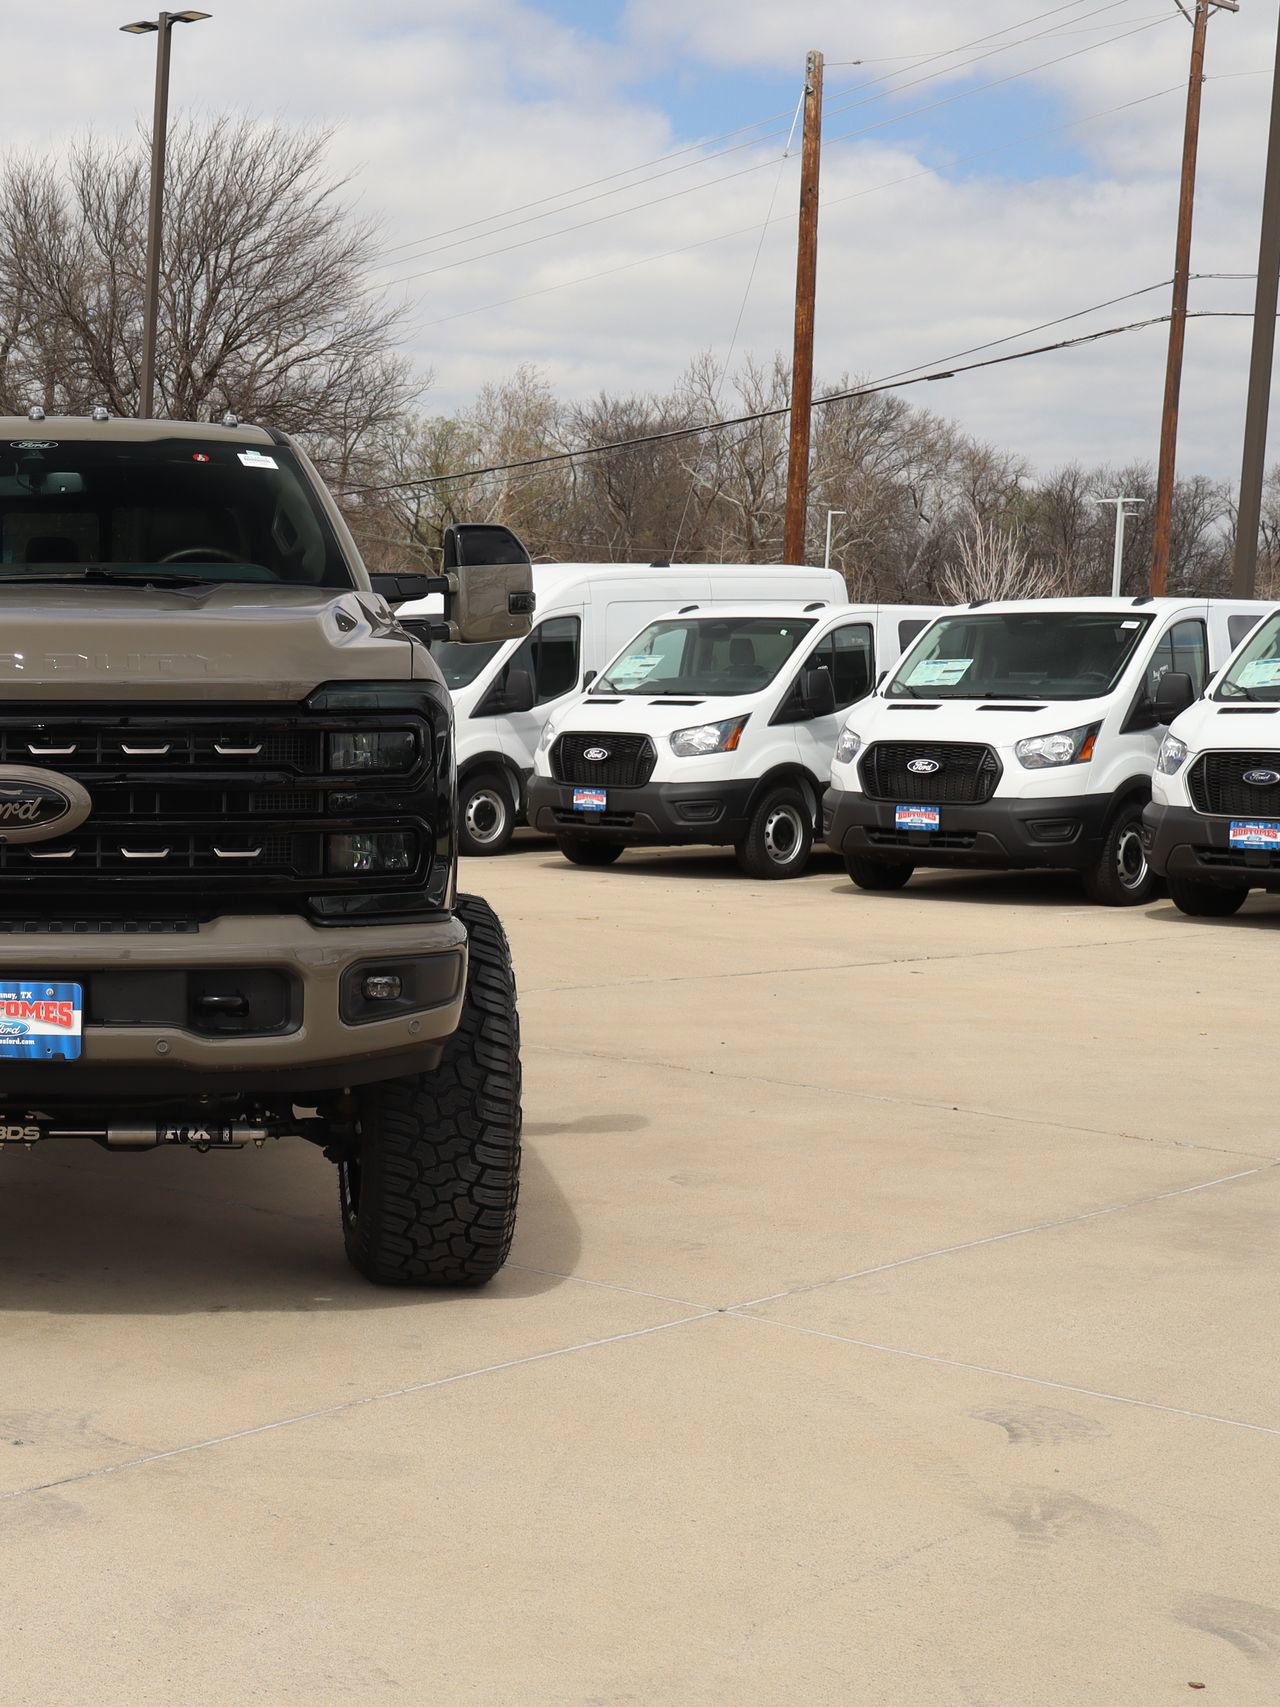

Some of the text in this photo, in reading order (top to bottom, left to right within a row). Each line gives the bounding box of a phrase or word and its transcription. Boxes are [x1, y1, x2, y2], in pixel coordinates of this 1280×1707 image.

[44, 652, 232, 672] DUTY
[913, 761, 933, 771] Ford
[1250, 772, 1270, 780] Ford
[20, 991, 33, 999] TX
